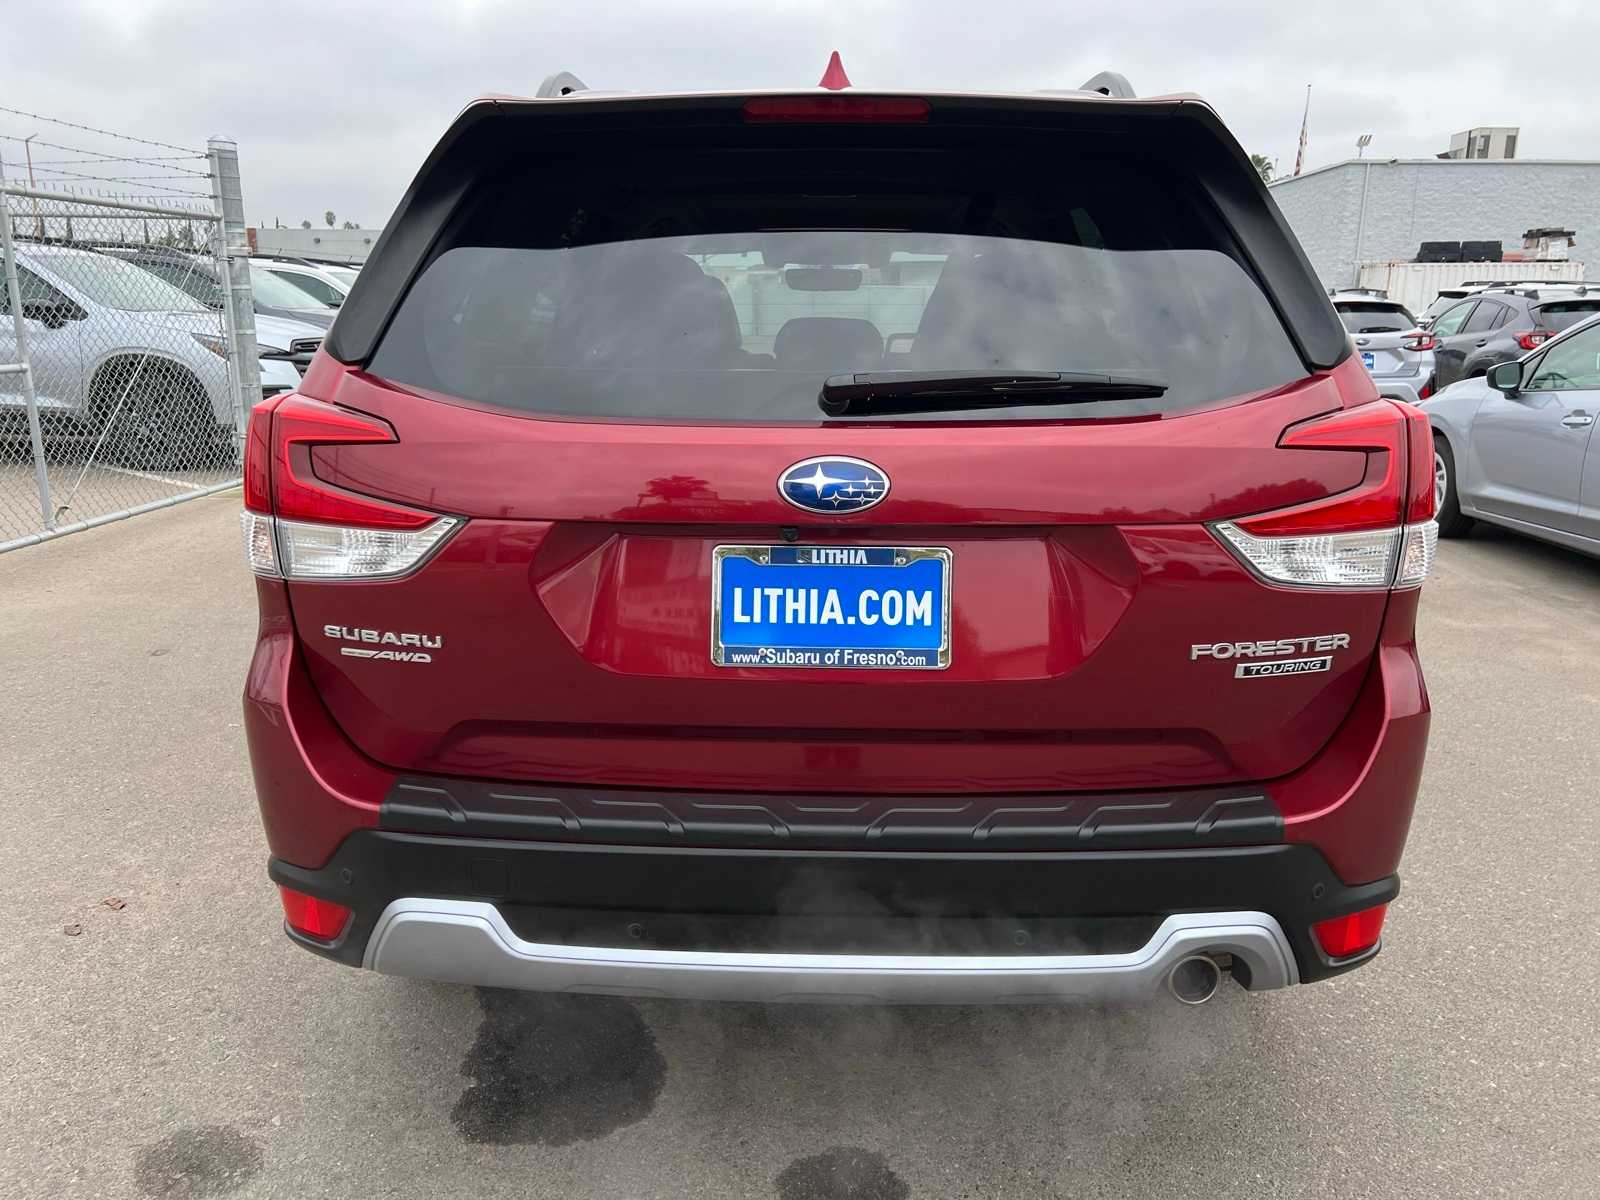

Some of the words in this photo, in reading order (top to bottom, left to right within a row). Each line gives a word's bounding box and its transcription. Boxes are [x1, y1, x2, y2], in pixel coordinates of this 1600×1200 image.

[811, 549, 868, 564] LITHIA
[733, 587, 933, 627] LITHIA.COM
[323, 624, 442, 649] SUBARU
[1191, 633, 1351, 660] FORESTER
[373, 650, 432, 663] AWD
[824, 649, 840, 665] of
[1249, 660, 1322, 675] TOURING
